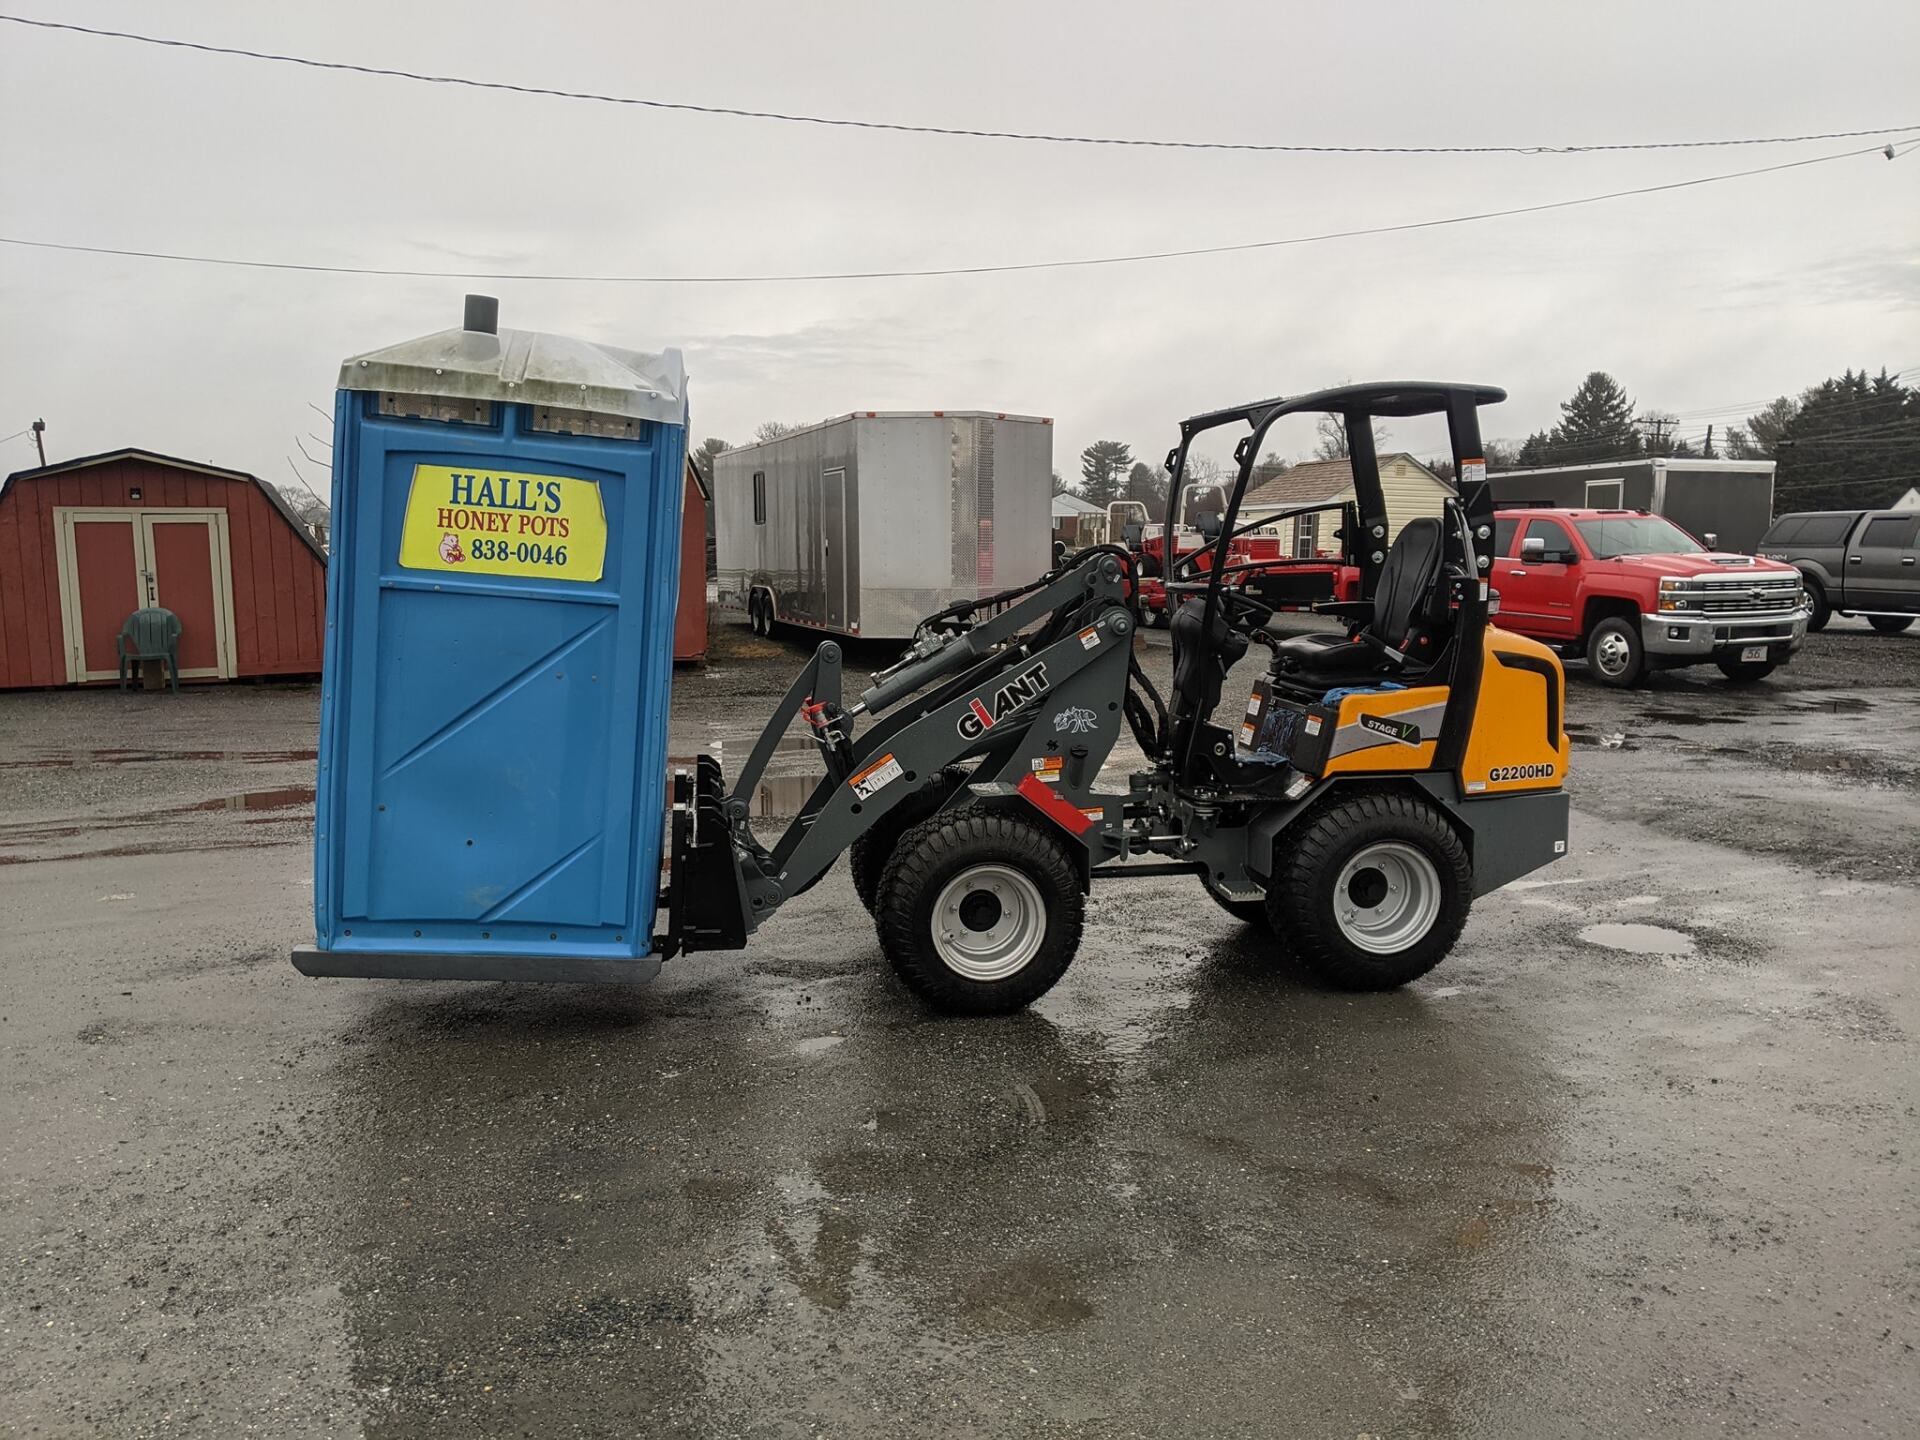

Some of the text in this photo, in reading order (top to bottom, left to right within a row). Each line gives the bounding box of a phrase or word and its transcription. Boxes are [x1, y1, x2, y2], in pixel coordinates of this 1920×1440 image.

[449, 473, 561, 513] HALL'S
[437, 508, 569, 538] HONEY POTS
[471, 538, 567, 566] 838-0046
[1367, 719, 1417, 739] STAGE V
[1489, 763, 1555, 782] G2200HD
